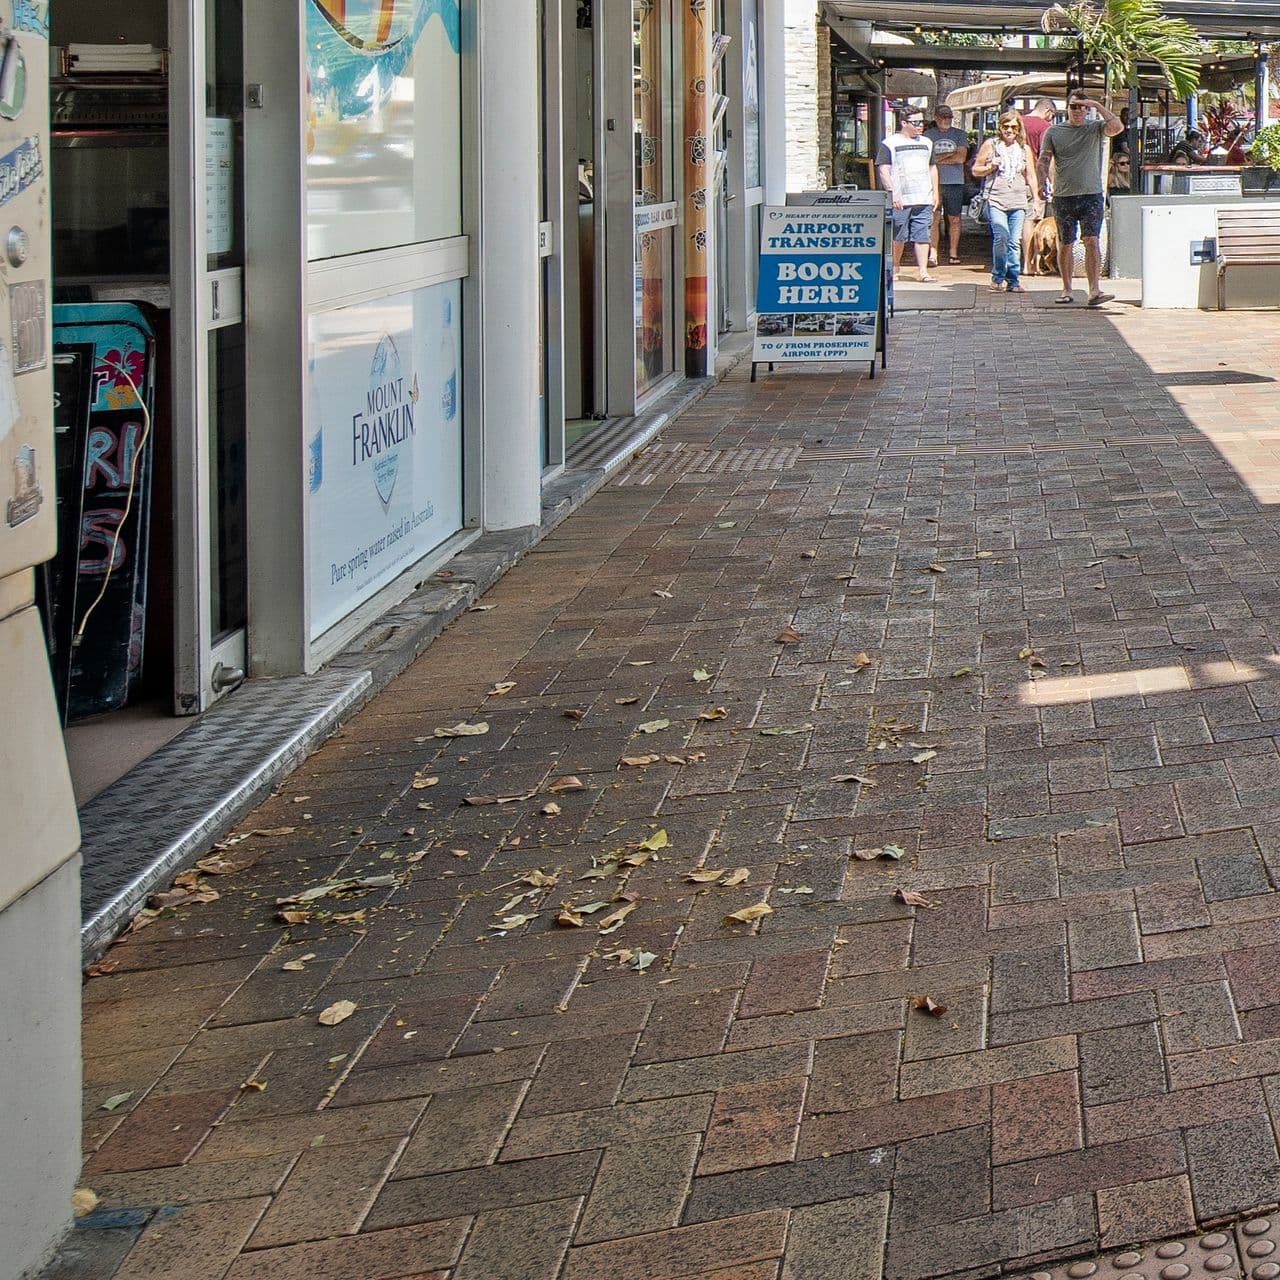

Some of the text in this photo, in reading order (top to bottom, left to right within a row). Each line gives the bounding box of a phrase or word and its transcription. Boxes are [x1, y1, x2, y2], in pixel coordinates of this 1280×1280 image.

[781, 222, 865, 235] AIRPORT
[768, 236, 876, 249] TRANSFERS
[776, 262, 863, 281] BOOK
[777, 285, 860, 305] HERE
[761, 342, 774, 350] TO
[785, 342, 812, 350] FROM
[813, 341, 870, 349] PROSERPINE
[781, 349, 848, 358] AIRPORT (PPP)
[367, 378, 404, 417] MOUNT
[353, 402, 416, 466] FRANKLIN
[331, 563, 347, 585] Pure
[348, 546, 369, 580] spring
